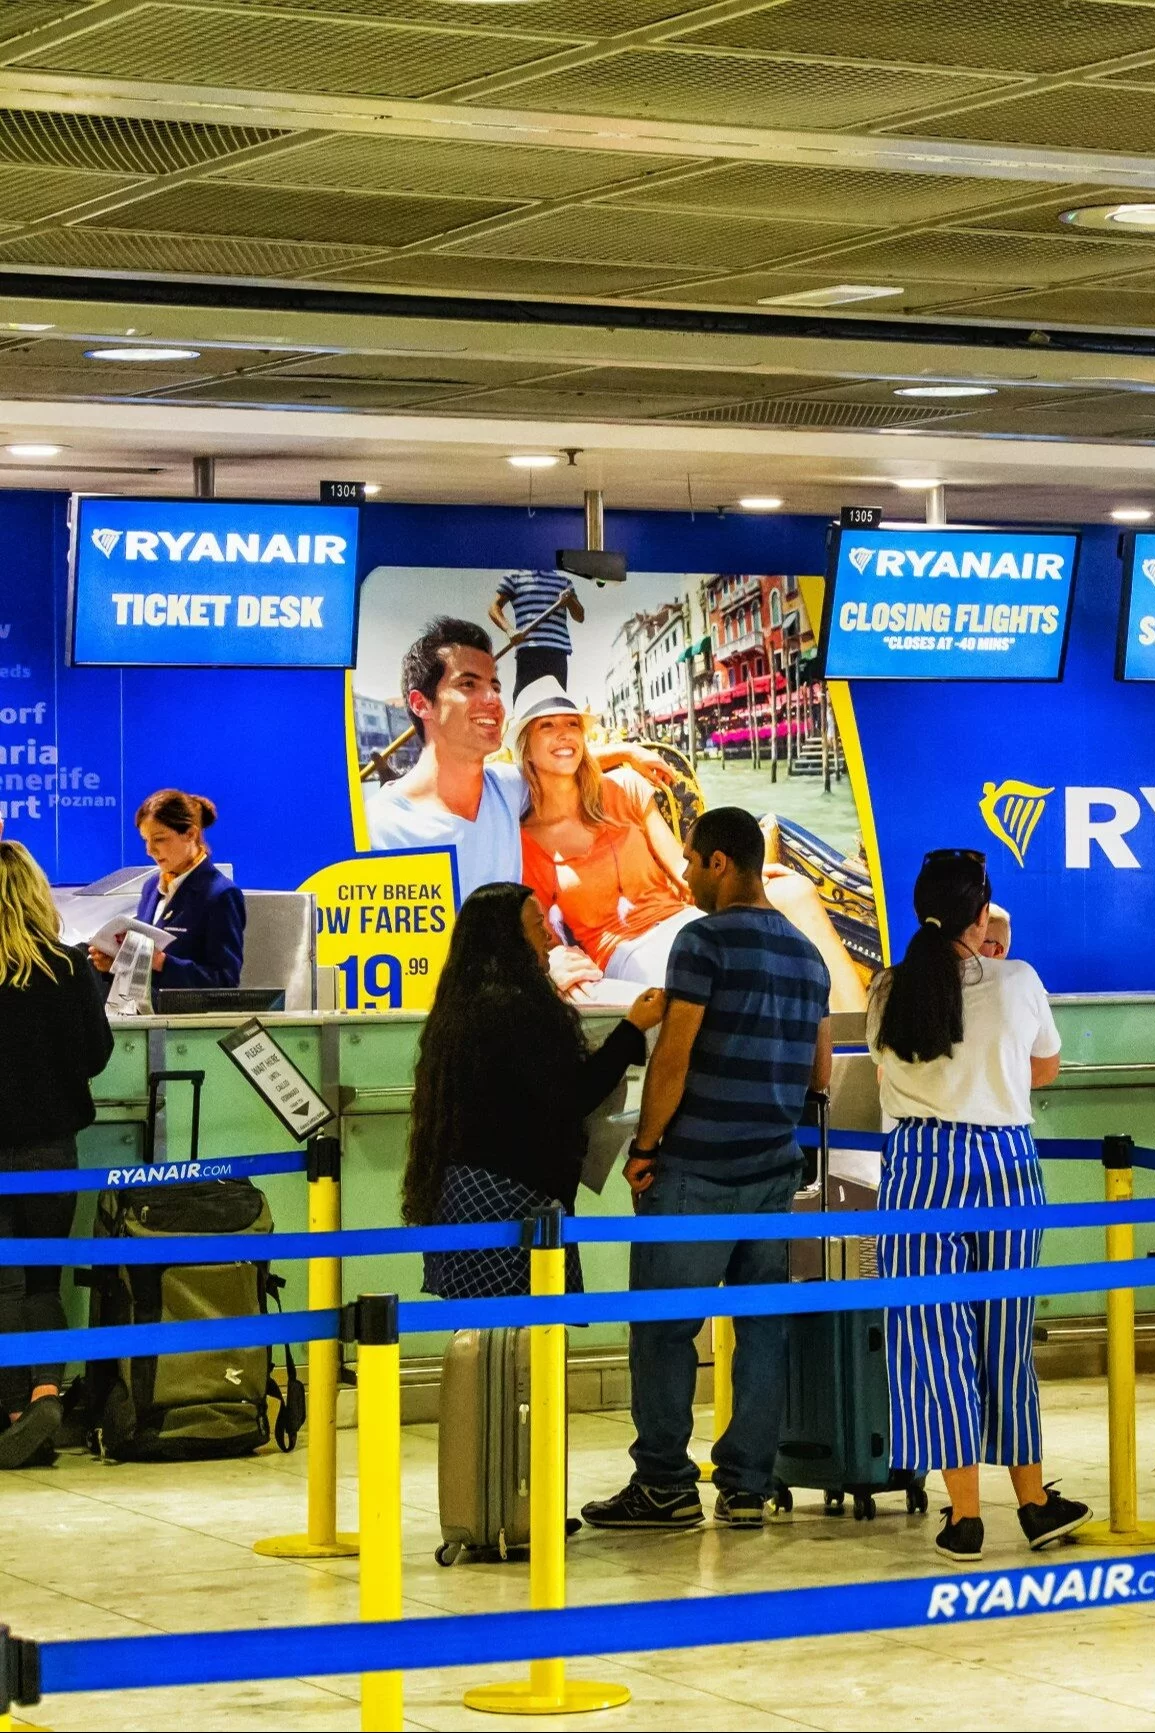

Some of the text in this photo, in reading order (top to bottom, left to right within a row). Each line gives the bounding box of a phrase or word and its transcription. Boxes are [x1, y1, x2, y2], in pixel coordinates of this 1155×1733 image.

[330, 485, 357, 498] 1304
[849, 510, 873, 523] 1305
[125, 530, 347, 564] RYANAIR
[876, 550, 1065, 580] RYANAIR
[111, 593, 324, 628] TICKET DESK
[839, 602, 1059, 634] CLOSING FLIGHTS
[936, 637, 954, 650] AT
[0, 767, 100, 791] nerife
[48, 794, 116, 808] Poznan
[338, 884, 441, 900] CITY BREAK
[360, 905, 445, 933] FARES
[244, 1043, 265, 1060] PLEASE
[250, 1062, 268, 1076] WAIT
[107, 1163, 232, 1185] RYANAIR.COM
